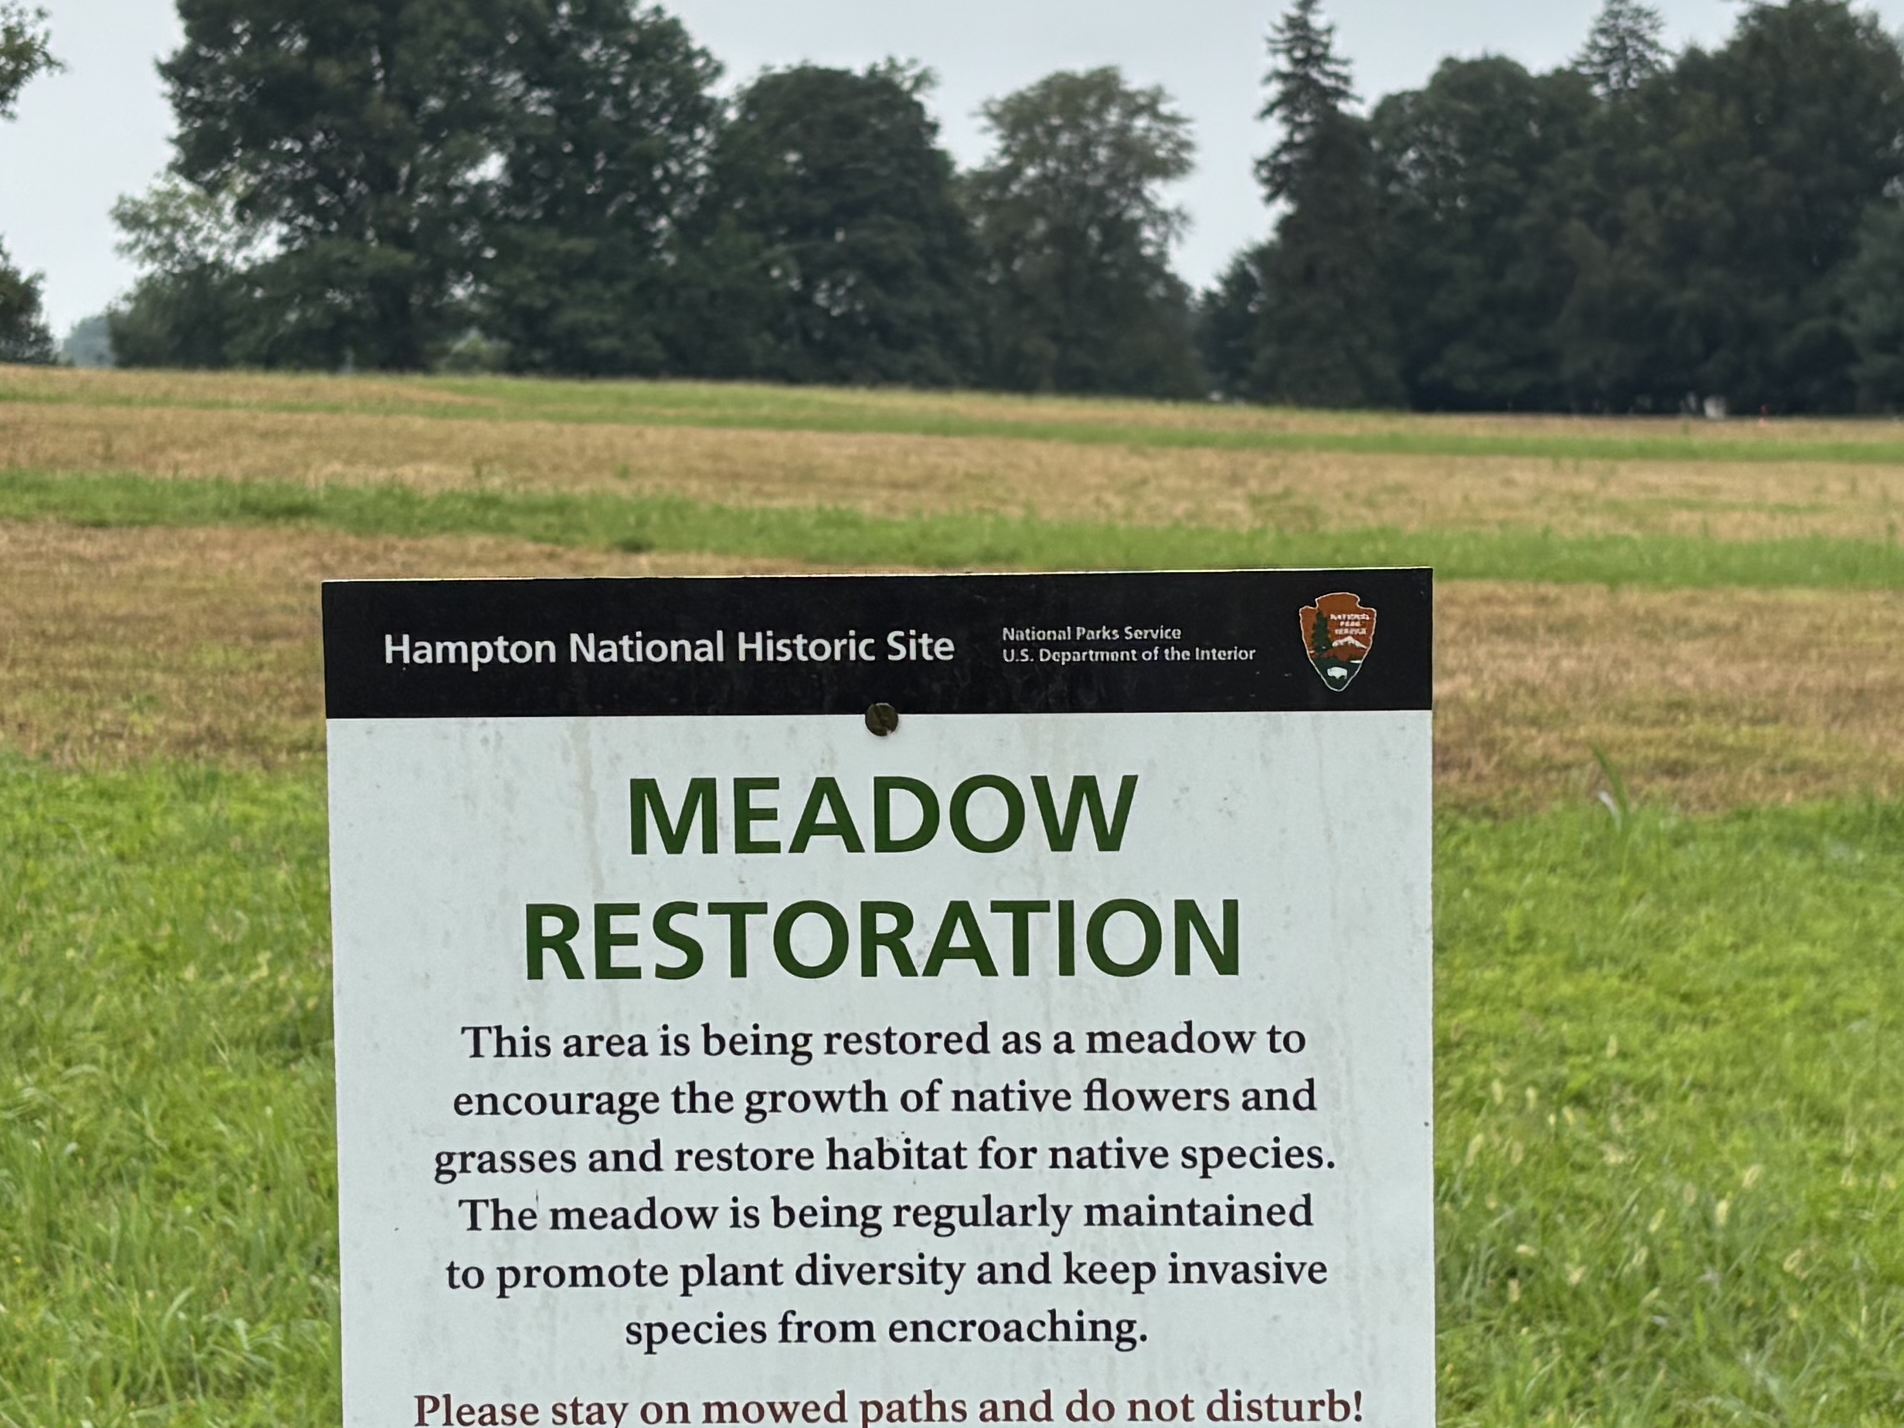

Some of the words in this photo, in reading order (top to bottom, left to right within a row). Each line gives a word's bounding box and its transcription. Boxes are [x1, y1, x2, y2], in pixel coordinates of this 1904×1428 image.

[384, 633, 556, 673] Hampton
[569, 629, 724, 663] National
[738, 629, 876, 662] Historic
[886, 629, 955, 661] Site
[1001, 647, 1034, 663] U.S.
[1038, 646, 1138, 666] Department
[1141, 646, 1161, 662] of
[1163, 645, 1191, 661] the
[1195, 645, 1257, 661] Interior
[1002, 625, 1072, 641] National
[1076, 625, 1120, 641] Parks
[1124, 625, 1182, 641] Service
[629, 774, 1139, 856] MEADOW
[525, 898, 1239, 981] RESTORATION
[460, 1024, 552, 1059] This
[563, 1033, 649, 1058] area
[659, 1023, 691, 1057] is
[700, 1022, 814, 1066] being
[823, 1020, 991, 1056] restored
[1001, 1030, 1042, 1055] as
[1053, 1030, 1076, 1055] a
[1085, 1019, 1257, 1054] meadow
[1266, 1024, 1306, 1054] to
[453, 1091, 660, 1125] encourage
[670, 1079, 734, 1115] the
[744, 1078, 889, 1124] growth
[900, 1077, 944, 1113] of
[951, 1078, 1072, 1113] native
[1083, 1077, 1230, 1112] flowers
[1241, 1077, 1318, 1112] and
[434, 1149, 577, 1184] grasses
[588, 1137, 664, 1173] and
[674, 1142, 815, 1172] restore
[825, 1136, 968, 1171] habitat
[978, 1135, 1038, 1170] for
[1048, 1136, 1169, 1170] native
[1180, 1135, 1335, 1180] species.
[458, 1195, 539, 1232] The
[549, 1195, 720, 1231] meadow
[729, 1195, 760, 1229] is
[770, 1194, 883, 1239] being
[892, 1192, 1074, 1238] regularly
[1083, 1192, 1314, 1227] maintained
[445, 1260, 485, 1290] to
[495, 1258, 669, 1299] promote
[679, 1252, 784, 1298] plant
[795, 1251, 967, 1296] diversity
[976, 1251, 1052, 1285] and
[1062, 1250, 1157, 1295] keep
[1168, 1251, 1328, 1285] invasive
[625, 1311, 767, 1356] species
[778, 1309, 877, 1344] from
[888, 1308, 1148, 1353] encroaching.
[413, 1393, 540, 1427] Please
[640, 1401, 692, 1425] on
[701, 1389, 849, 1424] mowed
[978, 1388, 1054, 1423] and
[1065, 1388, 1116, 1423] do
[1127, 1393, 1196, 1423] not
[1206, 1388, 1363, 1423] disturb!
